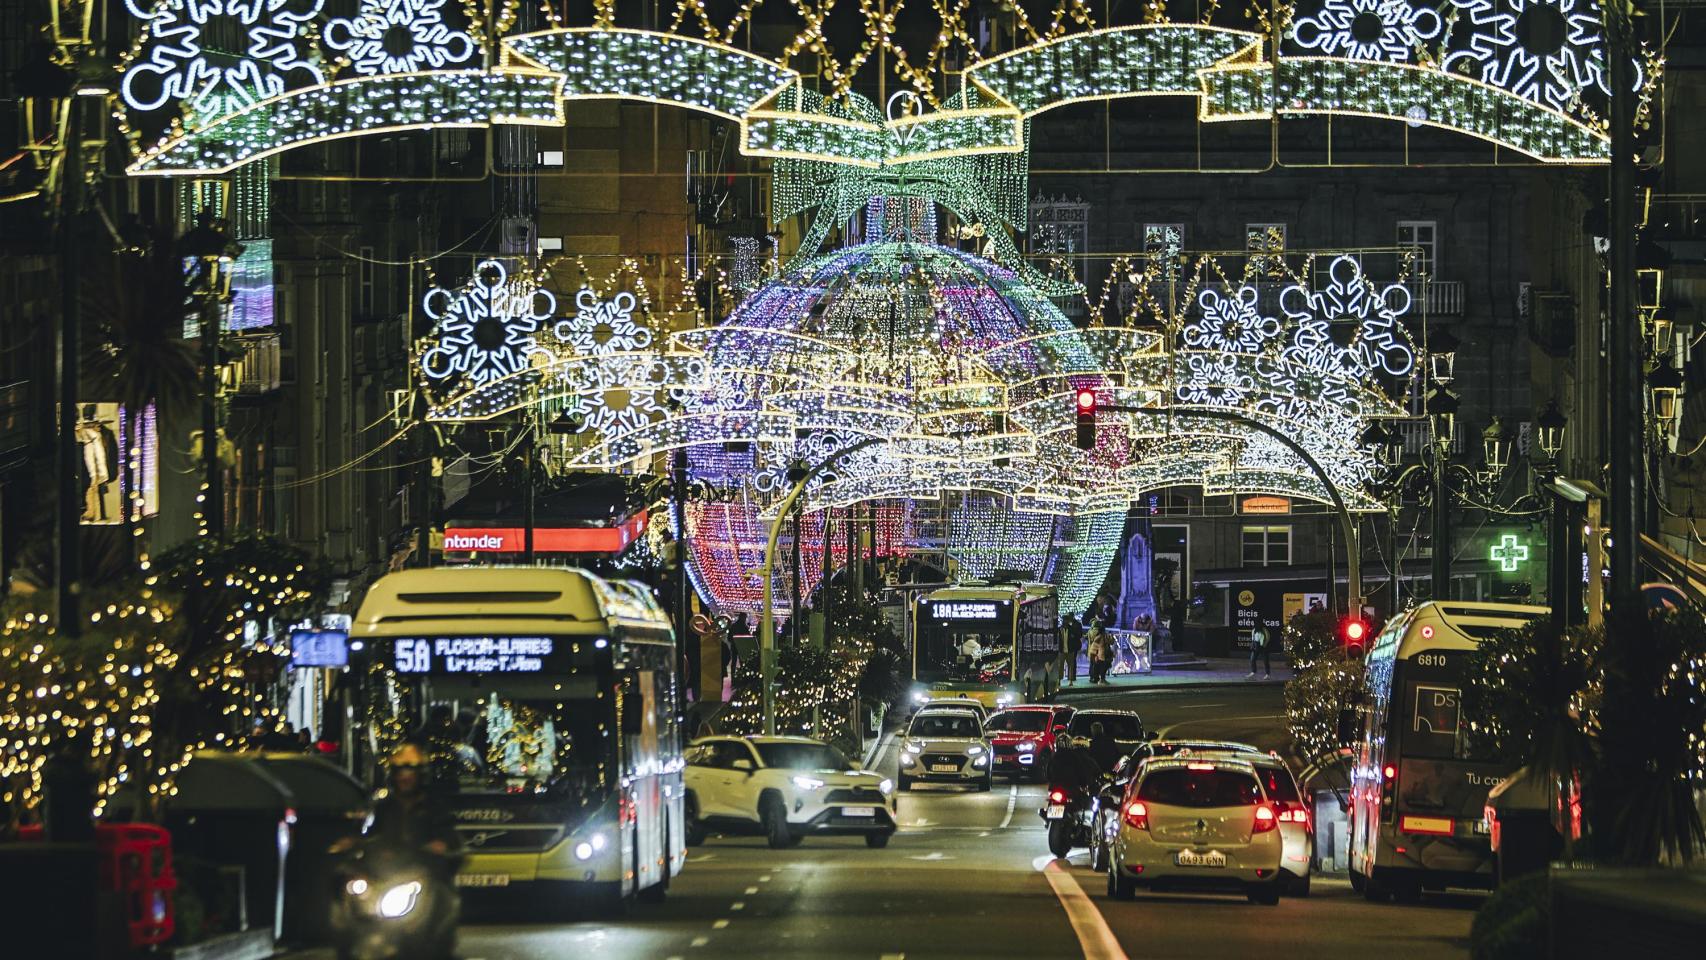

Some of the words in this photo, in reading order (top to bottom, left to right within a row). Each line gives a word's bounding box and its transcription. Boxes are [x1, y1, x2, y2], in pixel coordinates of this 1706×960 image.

[933, 604, 951, 618] 18A
[395, 639, 430, 672] 5A
[1418, 654, 1446, 667] 6810
[1466, 772, 1480, 785] Tu
[452, 809, 500, 820] vanza
[1180, 855, 1204, 865] 0493
[1206, 856, 1224, 865] GNN
